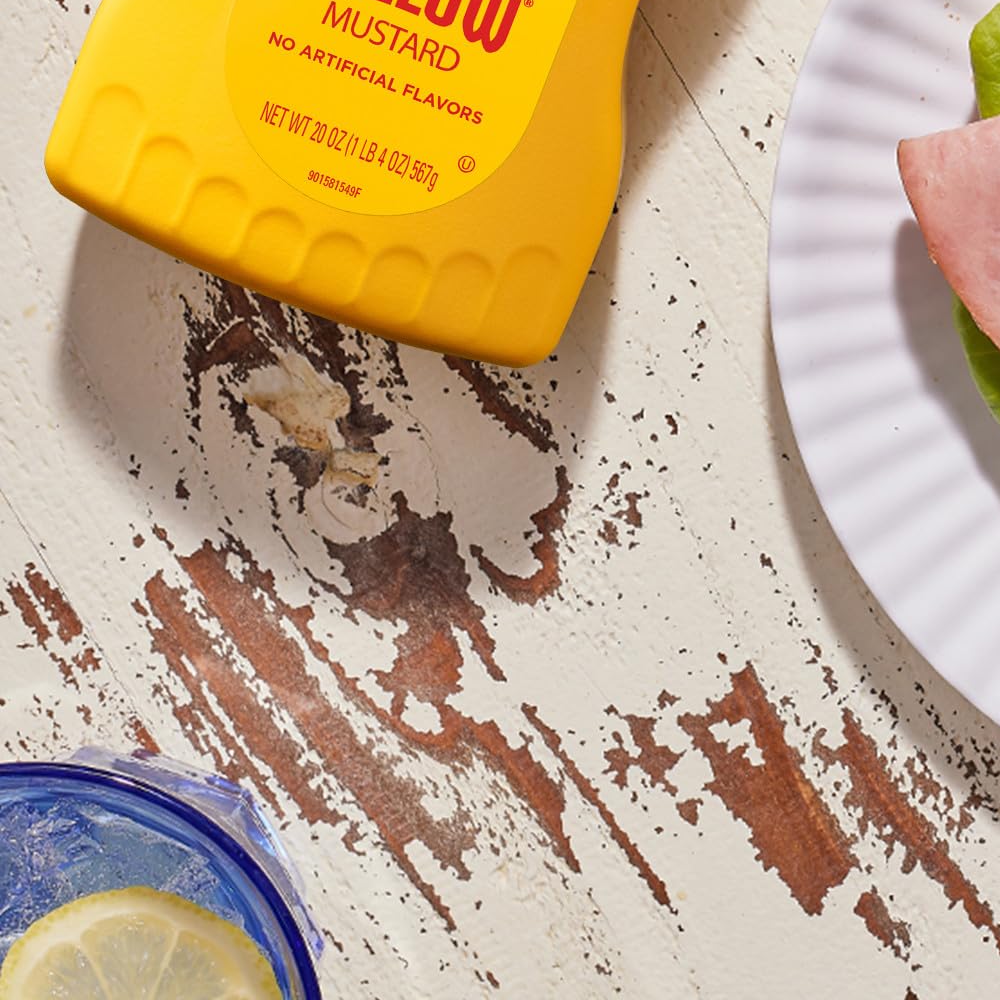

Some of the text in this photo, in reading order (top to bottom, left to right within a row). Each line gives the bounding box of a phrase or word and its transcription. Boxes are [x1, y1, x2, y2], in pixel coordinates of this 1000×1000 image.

[321, 0, 461, 73] MUSTARD
[268, 31, 484, 125] NO ARTIFICIAL FLAVORS
[259, 101, 439, 193] NET WT 20 OZ (1 LB 4 OZ) 567g
[307, 169, 363, 199] 901581549F
